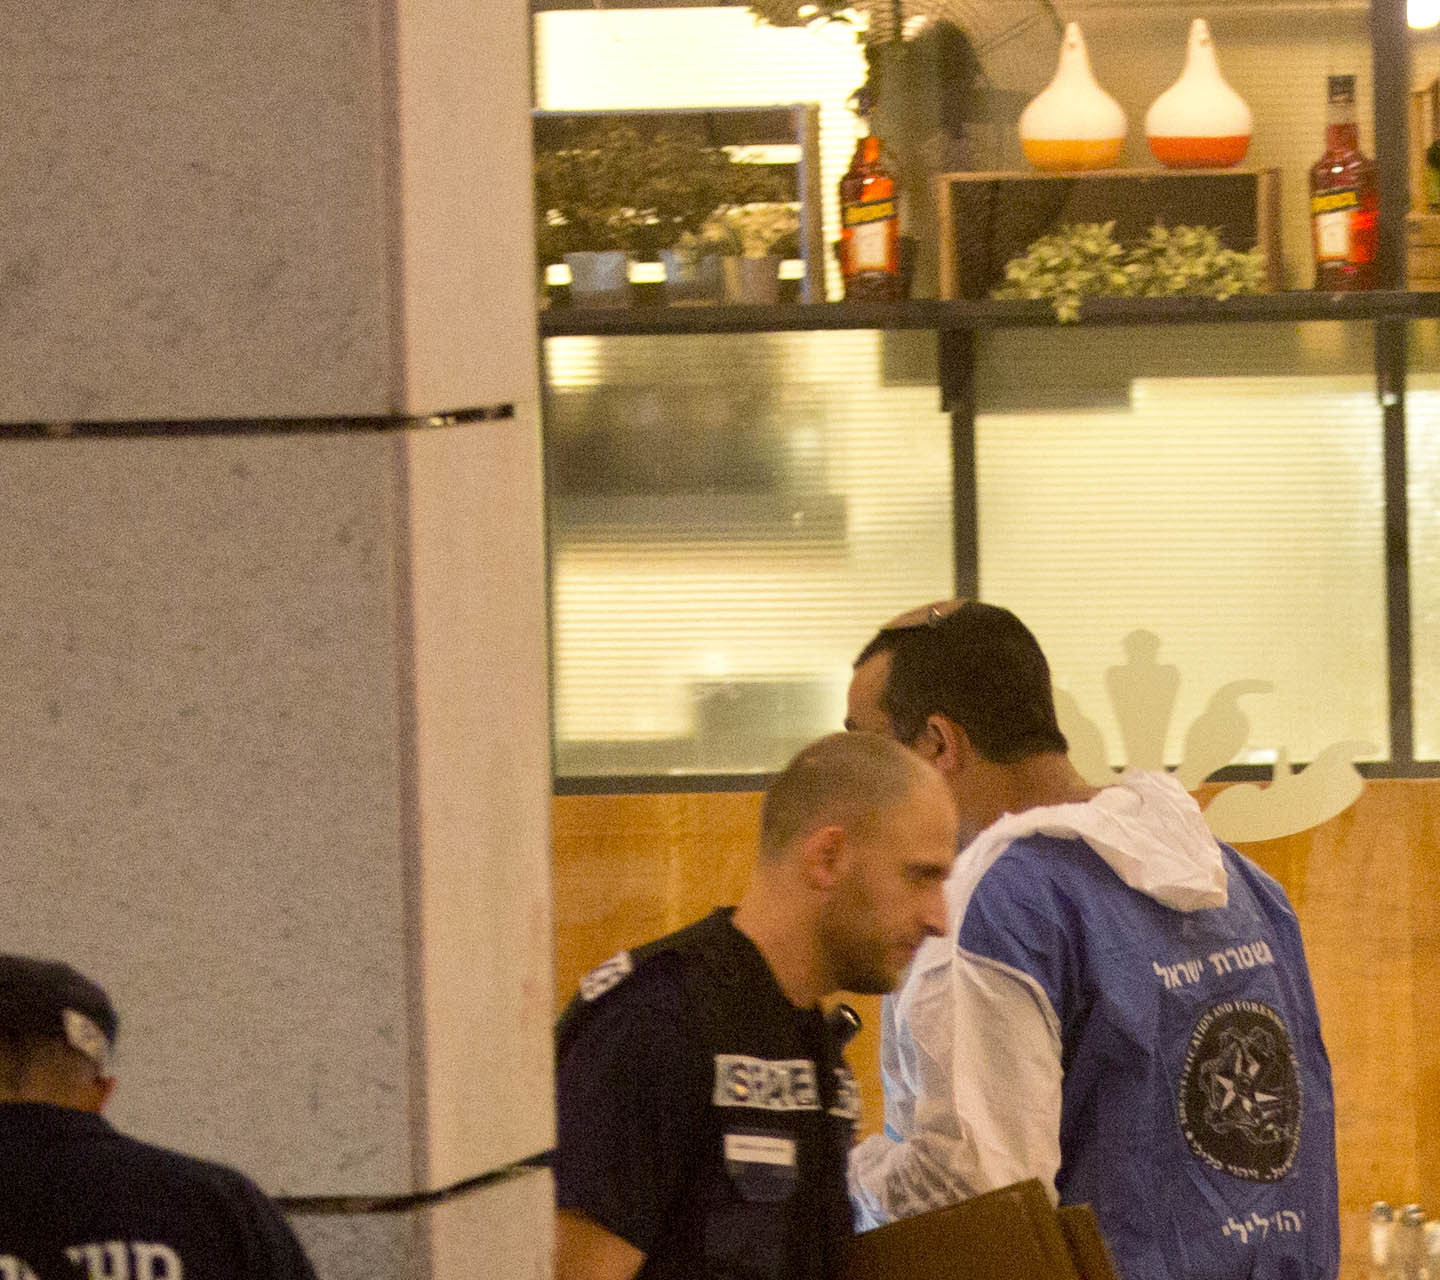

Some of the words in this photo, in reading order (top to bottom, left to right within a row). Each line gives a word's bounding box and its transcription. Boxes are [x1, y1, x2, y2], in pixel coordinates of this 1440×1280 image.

[1152, 957, 1205, 989] ישראל
[1208, 940, 1276, 976] שטרת
[1212, 1002, 1233, 1019] AND
